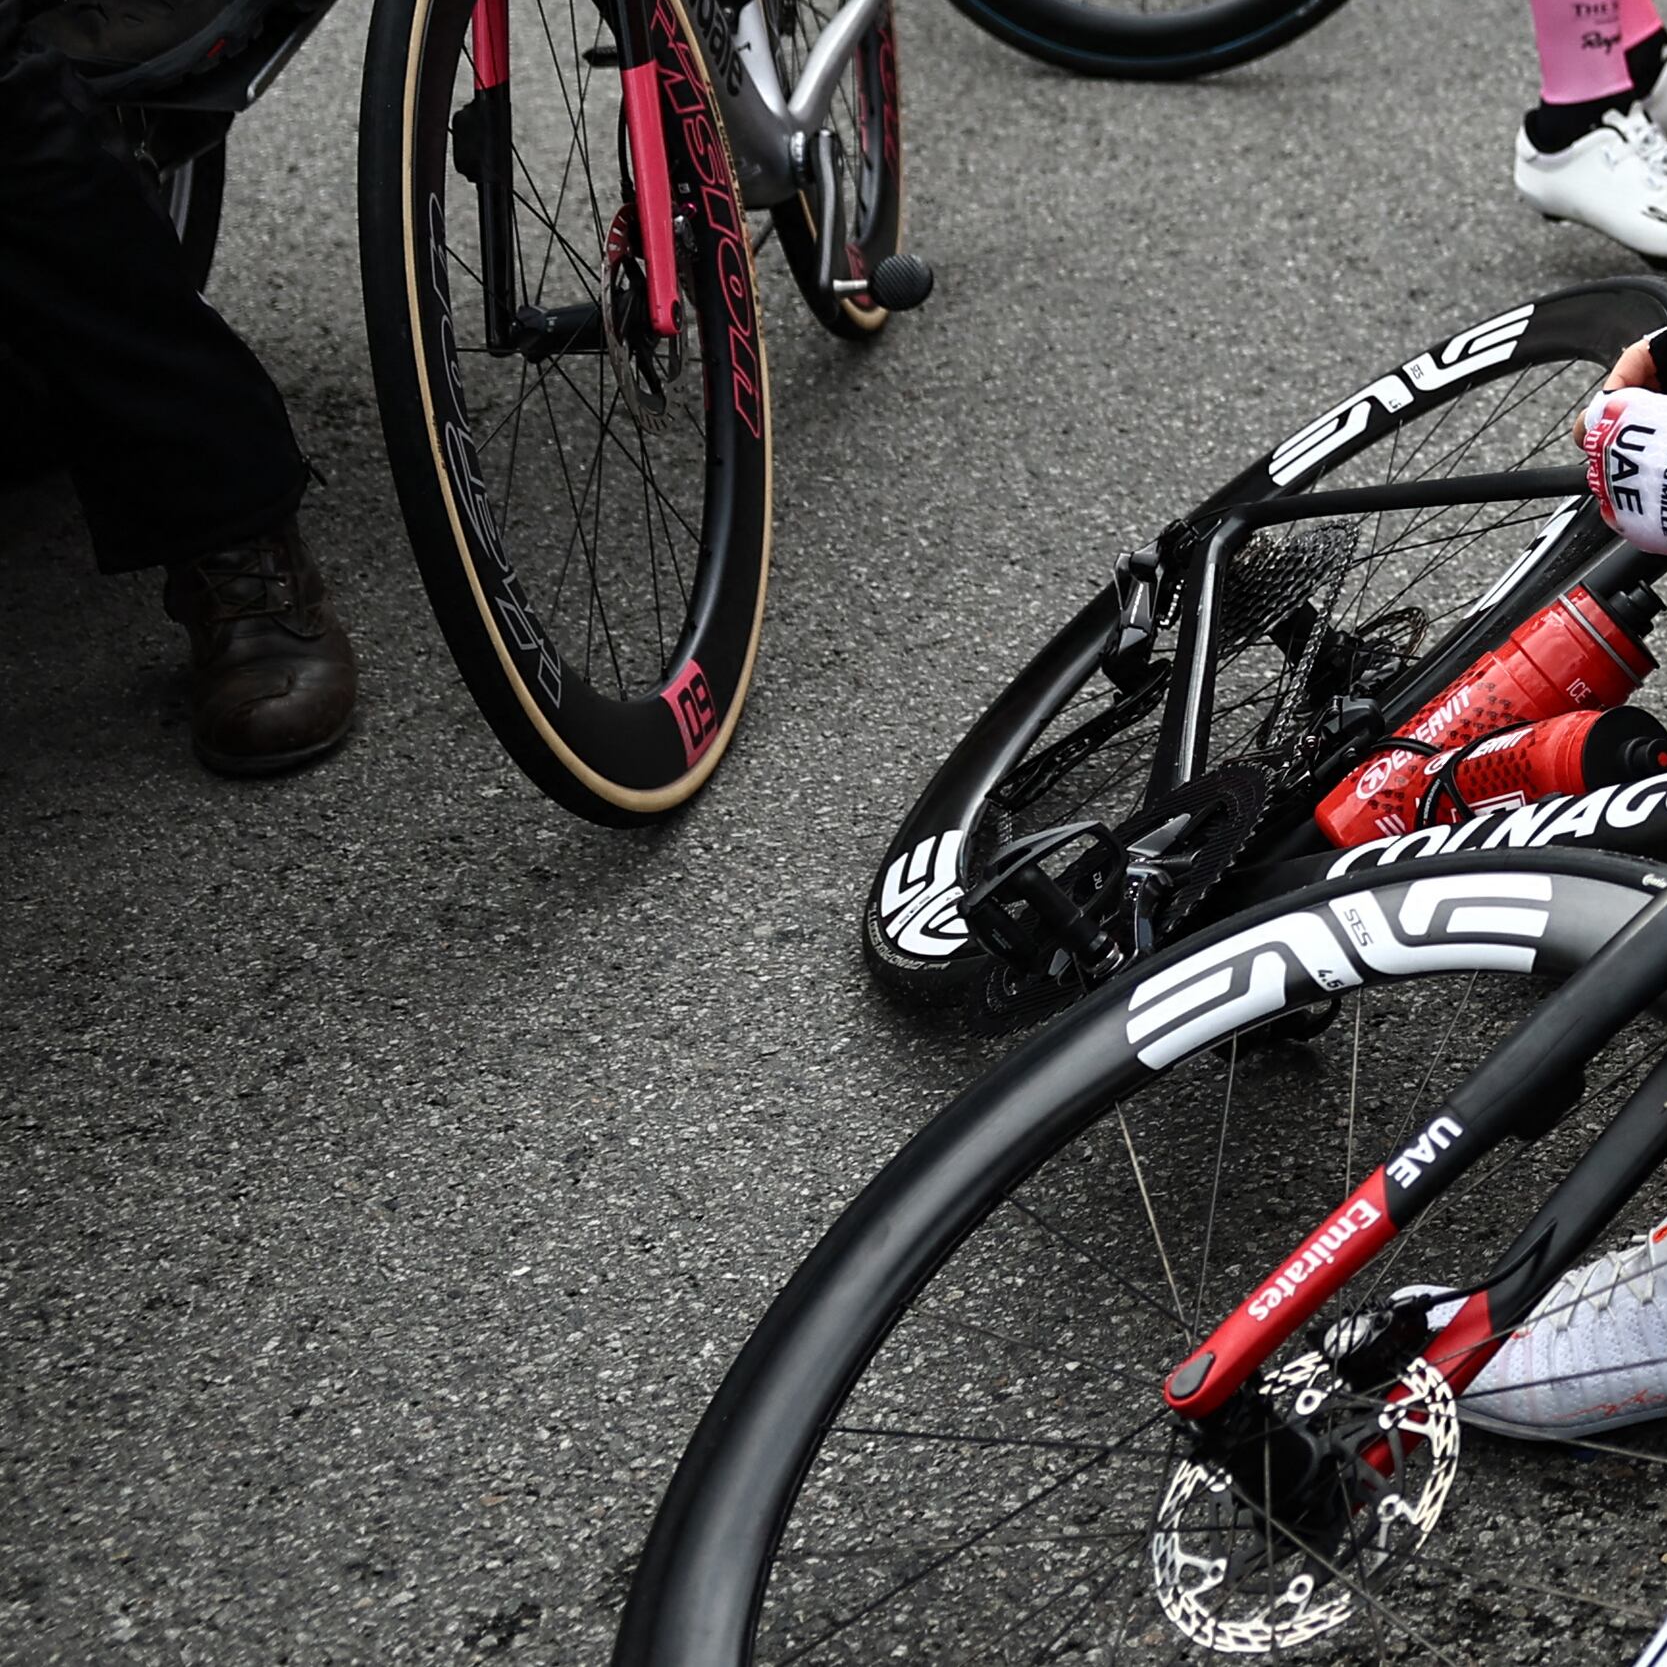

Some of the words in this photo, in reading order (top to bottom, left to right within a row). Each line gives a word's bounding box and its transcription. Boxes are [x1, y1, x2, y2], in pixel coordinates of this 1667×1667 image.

[1611, 424, 1656, 516] UAE
[1566, 678, 1591, 704] ICE
[1343, 907, 1374, 947] SES
[1385, 1114, 1466, 1190] UAE
[1246, 1199, 1384, 1322] Emirates
